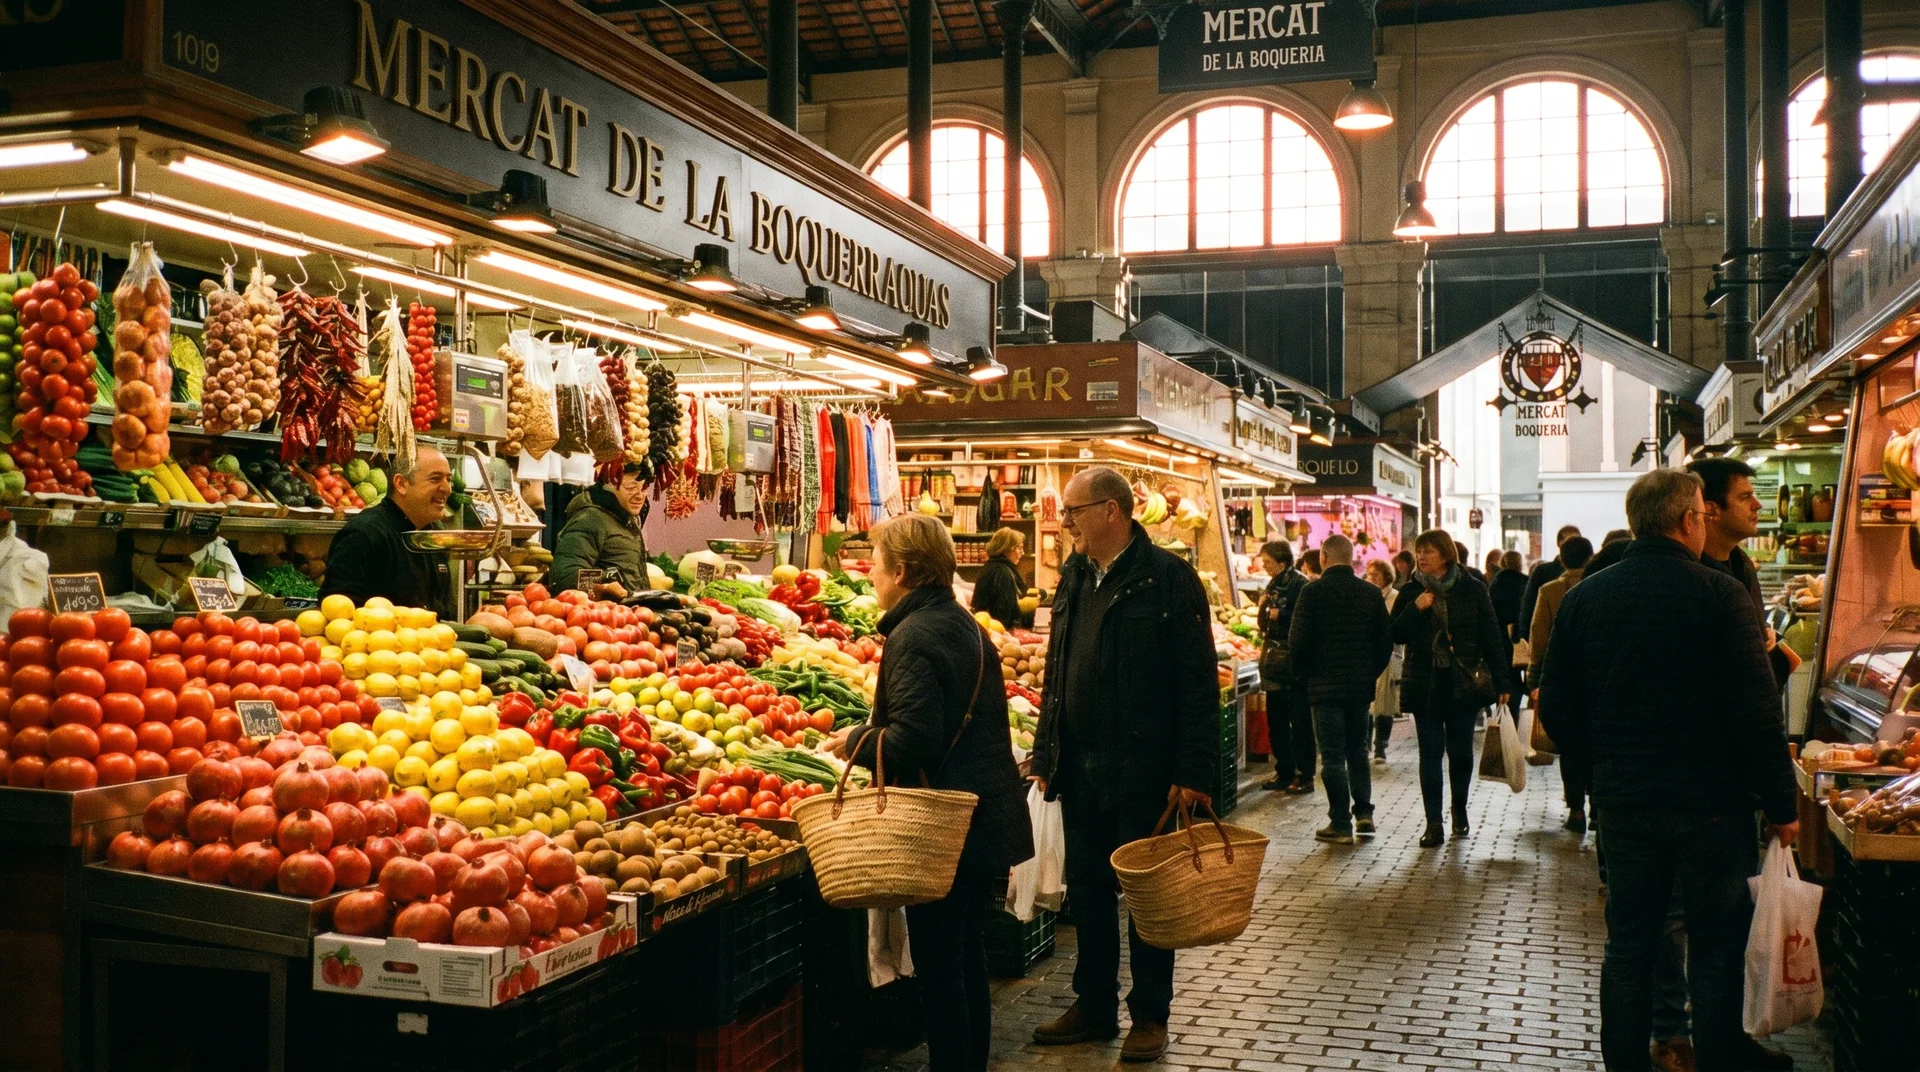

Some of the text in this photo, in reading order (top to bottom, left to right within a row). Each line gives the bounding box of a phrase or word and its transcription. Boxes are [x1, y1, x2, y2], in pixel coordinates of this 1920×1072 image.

[1203, 1, 1326, 44] MERCAT
[1202, 45, 1326, 72] DE LA BOQUERIA
[353, 0, 589, 178] MERCAT
[606, 121, 666, 213] DE
[684, 160, 736, 243] LA
[1516, 404, 1567, 419] MERCAT
[1515, 424, 1569, 437] BOQUERIA
